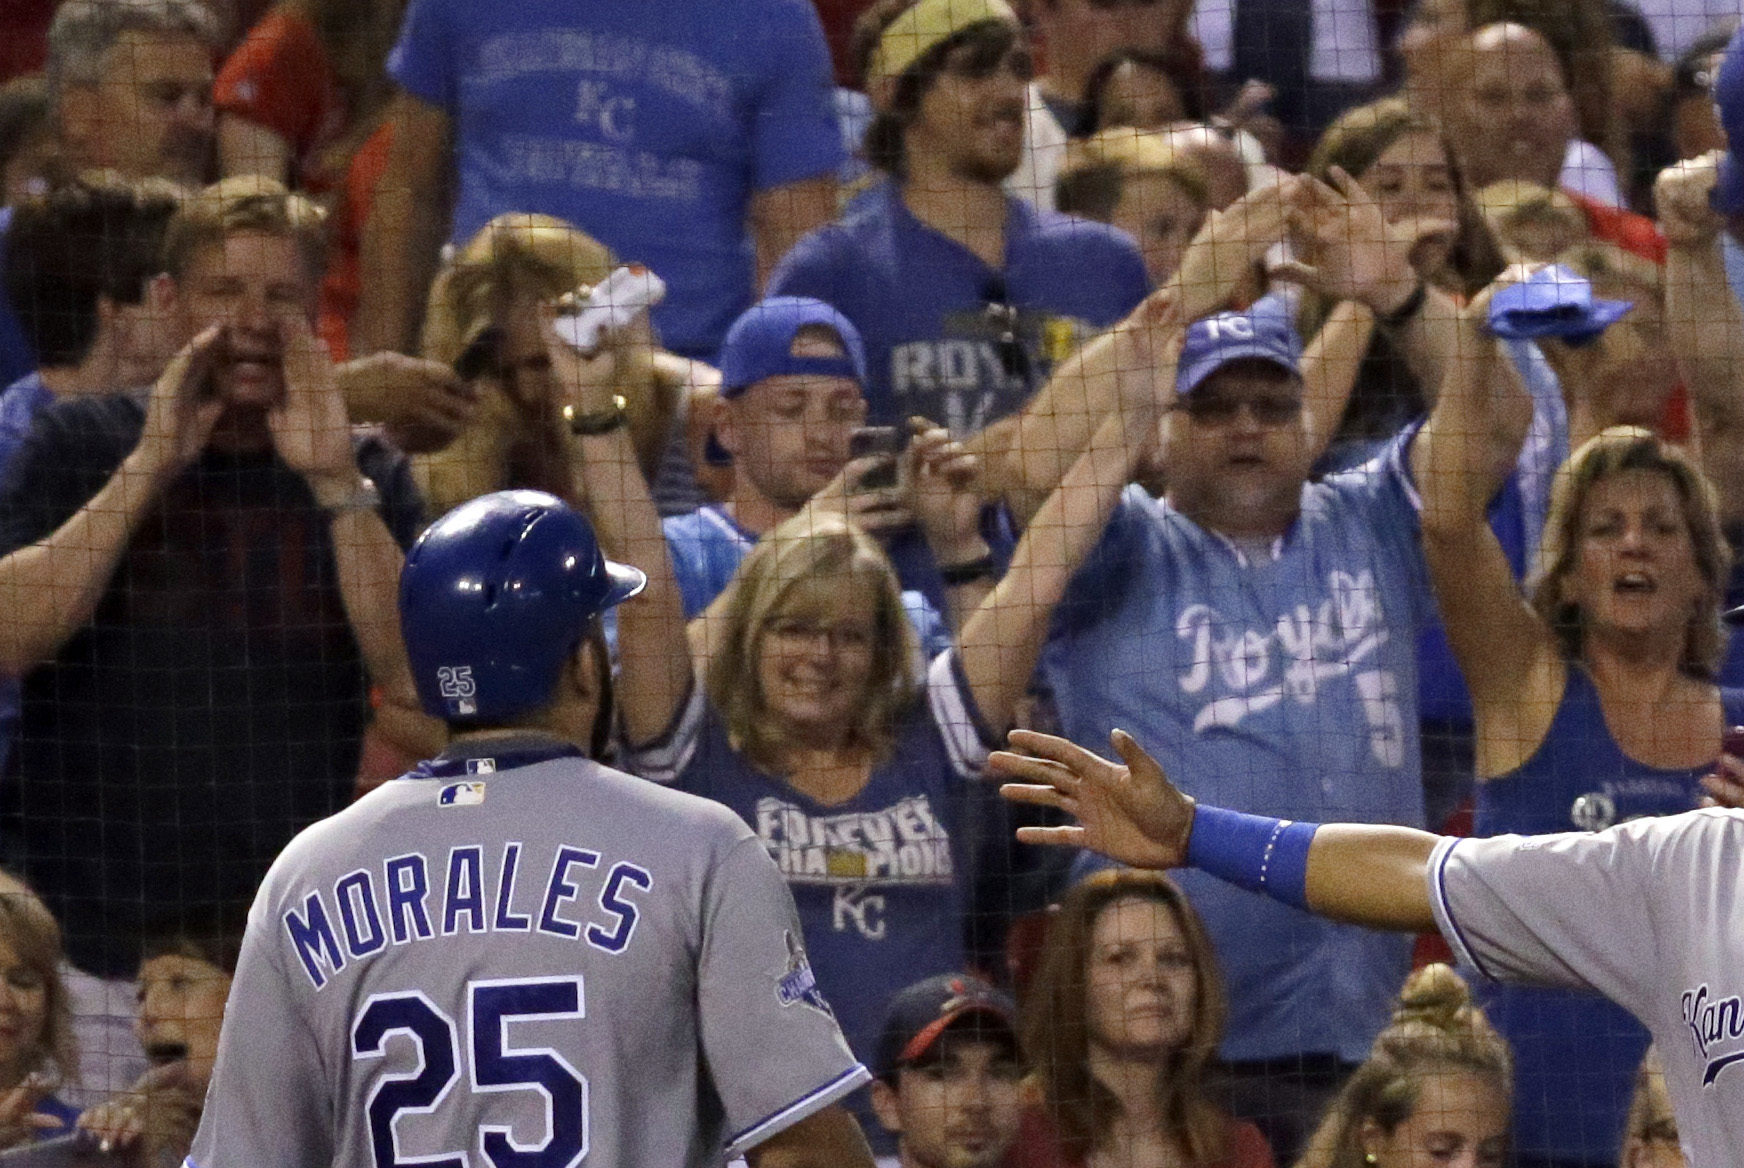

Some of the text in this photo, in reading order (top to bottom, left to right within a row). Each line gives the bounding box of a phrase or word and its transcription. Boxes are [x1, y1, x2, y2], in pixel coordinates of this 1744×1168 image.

[437, 666, 477, 698] 25
[282, 841, 654, 993] MORALES
[833, 883, 887, 940] KC
